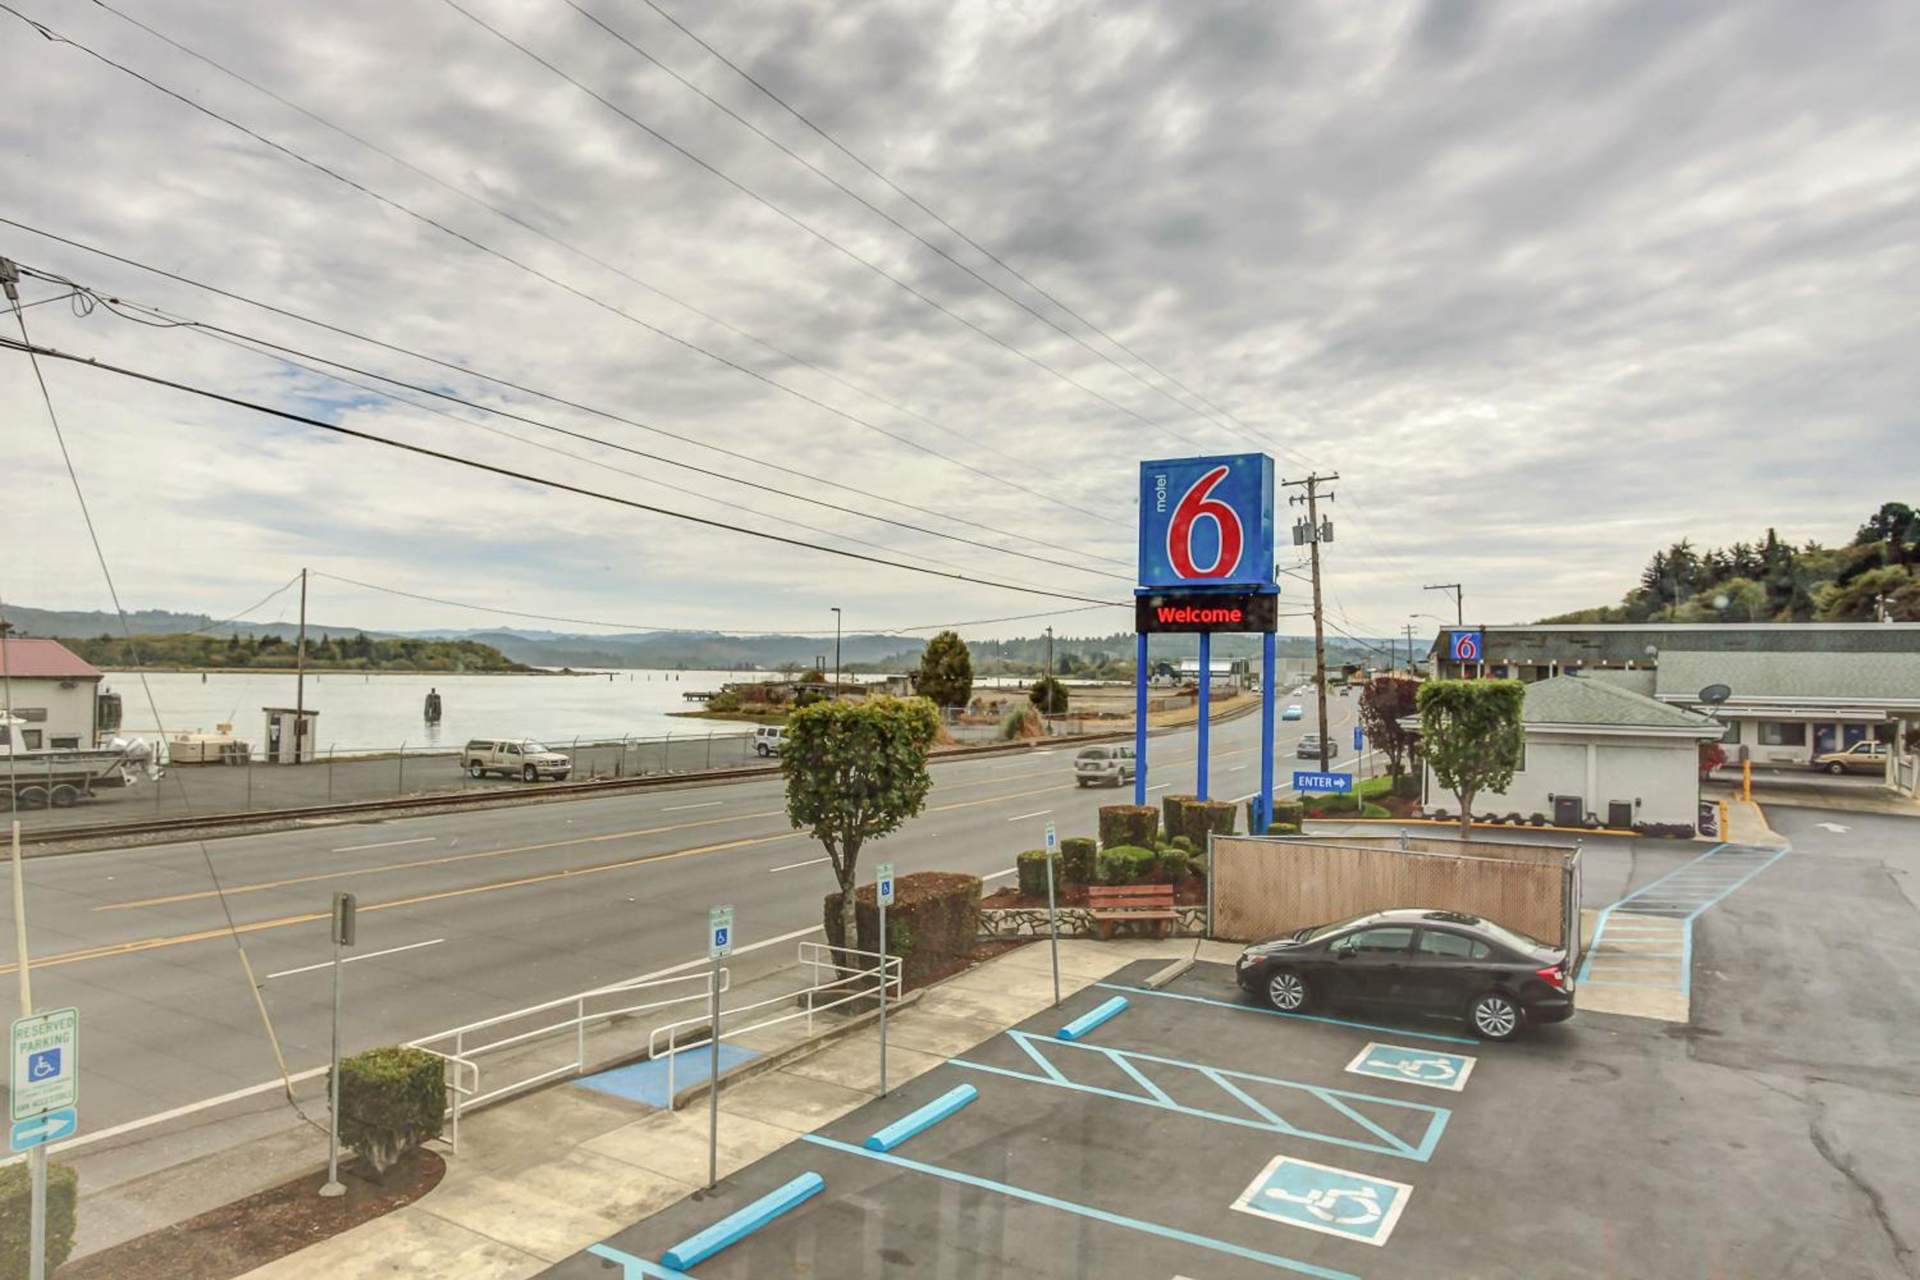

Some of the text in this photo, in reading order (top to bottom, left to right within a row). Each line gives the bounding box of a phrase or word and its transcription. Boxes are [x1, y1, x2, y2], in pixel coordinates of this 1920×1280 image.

[1155, 465, 1243, 579] motel 6
[1157, 607, 1242, 622] Welcome
[1456, 633, 1476, 660] 6
[1298, 775, 1332, 788] ENTER
[15, 1017, 74, 1040] RESERVED
[19, 1032, 70, 1054] PARKING
